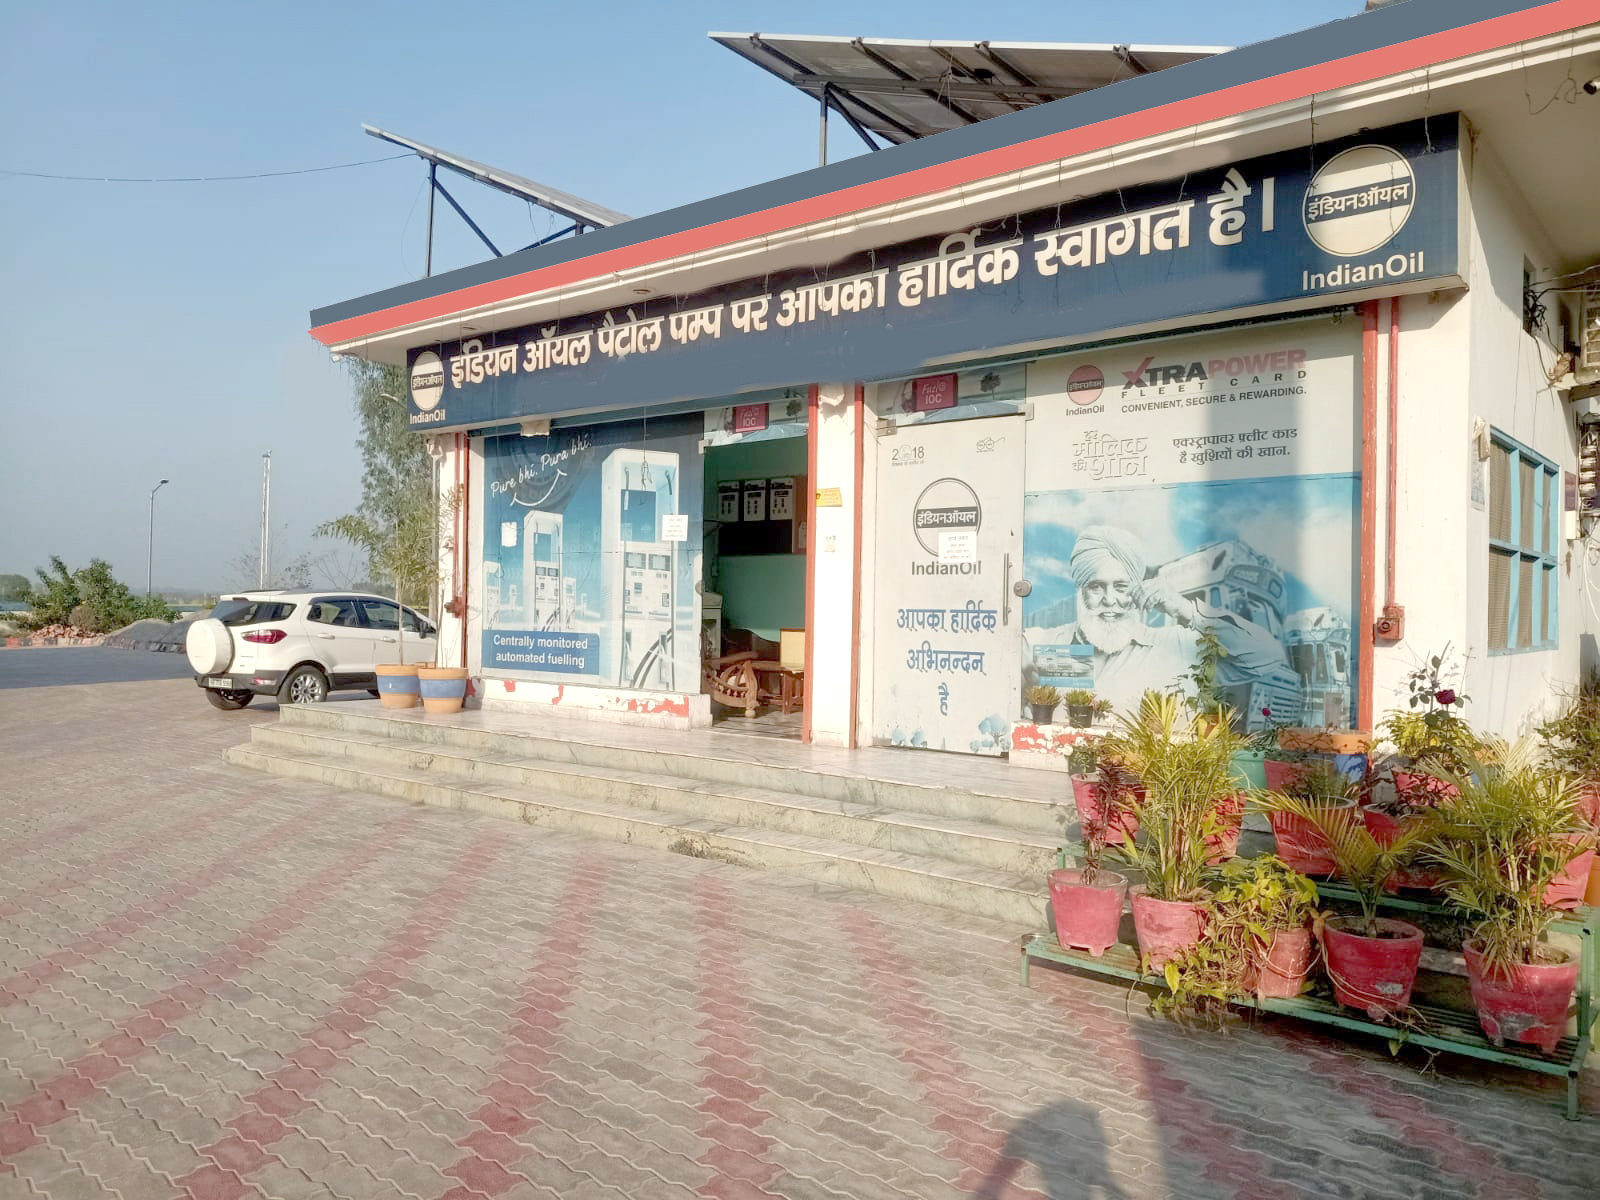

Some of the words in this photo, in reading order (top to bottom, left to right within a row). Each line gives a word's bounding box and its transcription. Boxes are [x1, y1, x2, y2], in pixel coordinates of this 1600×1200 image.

[1308, 182, 1411, 221] इंडियनऑयल
[668, 303, 724, 345] पम्प
[730, 293, 773, 333] पर
[775, 267, 889, 328] आपका
[1033, 199, 1195, 277] स्वागत
[1302, 251, 1424, 291] IndianOil
[1121, 382, 1206, 399] FLEET
[1230, 370, 1307, 387] CARD
[1066, 404, 1105, 417] IndianOil
[1121, 399, 1184, 414] CONVENIENT,
[1185, 394, 1226, 407] SECURE
[1229, 393, 1236, 403] &
[1239, 385, 1307, 401] REWARDING.
[409, 409, 446, 425] IndianOil
[1236, 445, 1254, 459] की
[917, 510, 977, 527] इंडियनऑयल
[911, 560, 982, 576] IndianOil
[896, 607, 948, 632] आपका
[949, 599, 998, 634] हार्दिक
[493, 634, 535, 650] Centrally
[537, 636, 588, 650] monitored
[495, 651, 545, 664] automated
[547, 652, 585, 669] fuelling
[906, 640, 987, 676] अभिनन्दन
[937, 682, 950, 717] है
